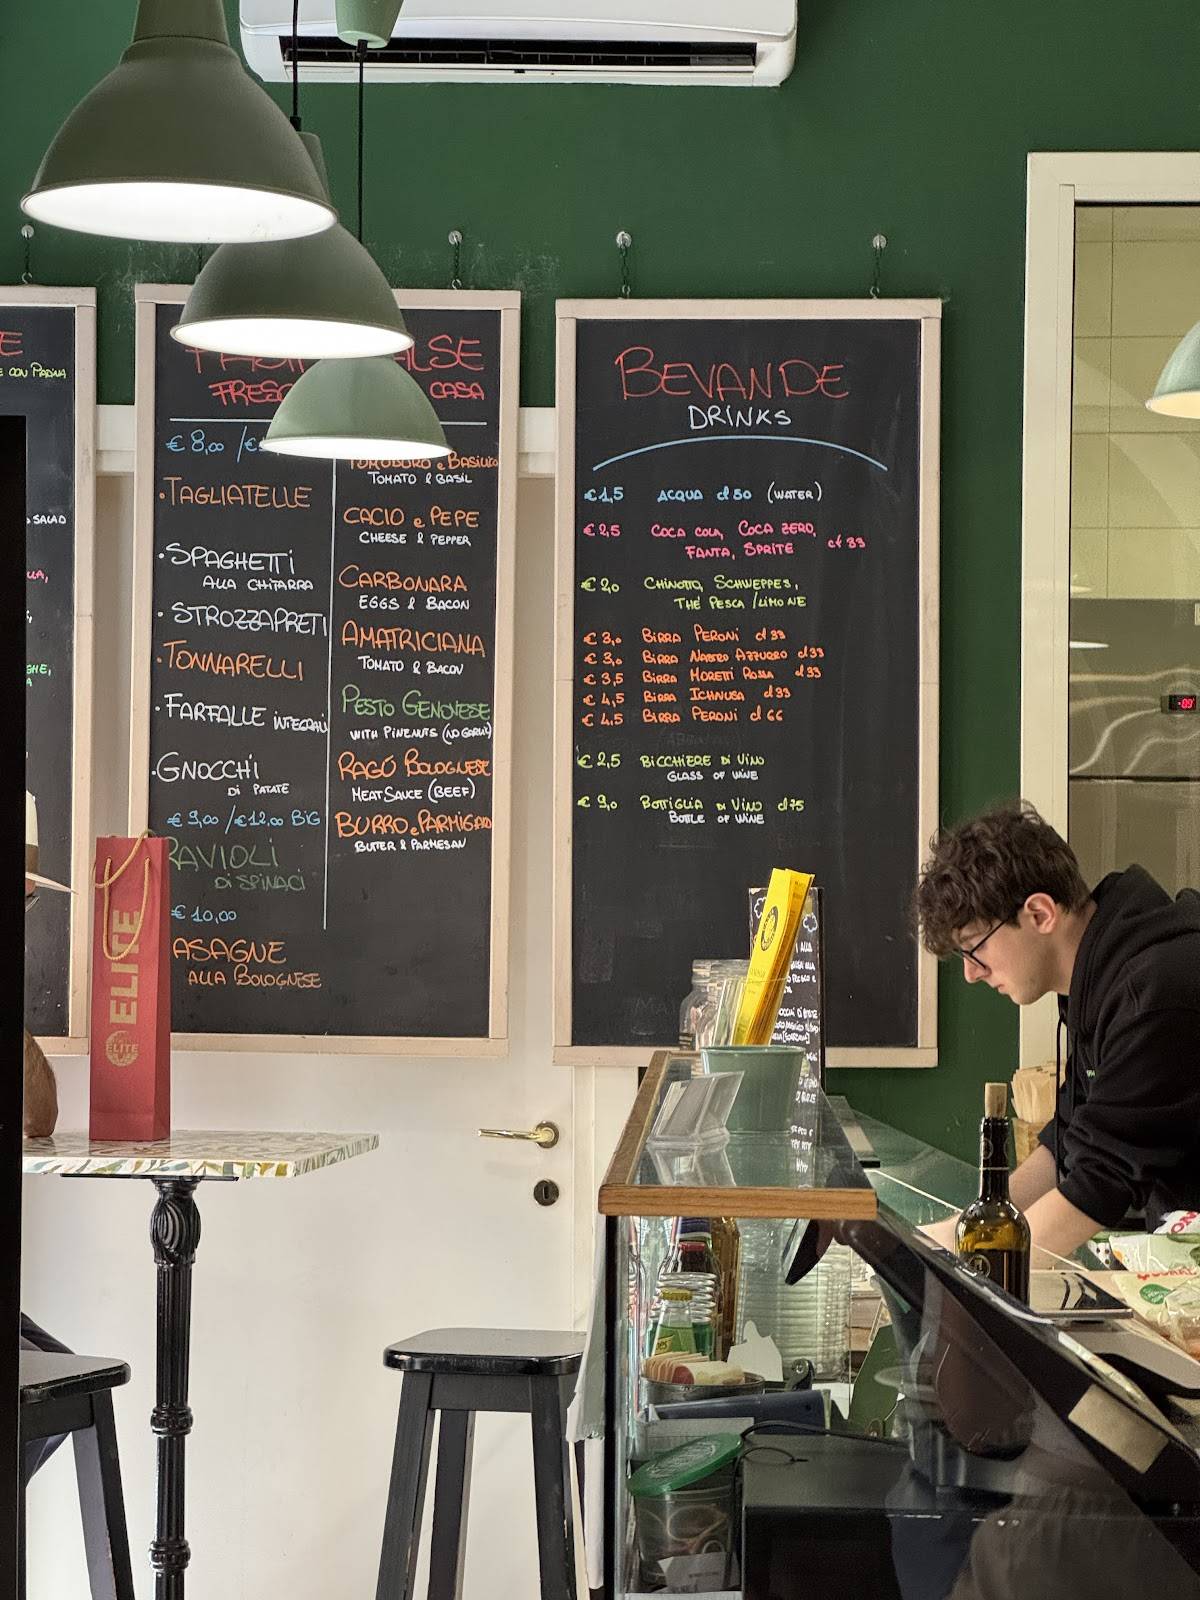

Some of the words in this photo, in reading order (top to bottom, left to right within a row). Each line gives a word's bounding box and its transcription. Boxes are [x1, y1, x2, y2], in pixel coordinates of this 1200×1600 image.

[615, 347, 848, 401] BEVANDE
[429, 381, 485, 401] CASA
[688, 405, 791, 429] DRINKS
[367, 471, 416, 484] TOMATO
[436, 473, 472, 484] BASIL
[164, 477, 312, 508] TAGLIATELLE
[657, 490, 703, 502] ACQUA
[768, 481, 821, 503] (WATER)
[33, 514, 66, 524] SALAD
[344, 507, 404, 525] CACIO
[430, 506, 479, 527] PEPE
[651, 524, 685, 537] COCA
[738, 520, 773, 536] COCA
[782, 523, 816, 537] ZERO,
[359, 532, 407, 544] CHEESE
[431, 534, 471, 546] PEPPER
[166, 543, 294, 574] SPAGHETTI
[685, 546, 735, 560] FANTA,
[744, 542, 793, 556] SPRITE
[203, 575, 236, 589] ALLA
[339, 565, 467, 592] CARBONARA
[359, 595, 399, 610] EGGS
[426, 596, 469, 610] BACON
[709, 596, 744, 609] PESCA
[172, 602, 327, 636] STROZZAPRETI
[342, 620, 485, 657] AMATRICIANA
[642, 628, 681, 643] BIRRA
[694, 624, 739, 641] PERONI
[163, 640, 302, 681] TONNARELLI
[358, 656, 404, 671] TOMATO
[426, 661, 463, 675] BACON
[643, 650, 678, 664] BIRRA
[643, 670, 677, 684] BIRRA
[690, 667, 734, 681] MORETTI
[342, 684, 394, 717] PESTO
[402, 690, 490, 720] GENOVESE
[644, 691, 676, 702] BIRRA
[690, 688, 744, 701] ICHNUSA
[164, 693, 266, 726] FARFALLE
[643, 709, 680, 723] BIRRA
[692, 706, 737, 721] PERONI
[350, 729, 378, 740] WITH
[157, 752, 259, 782] GNOCCHI
[404, 748, 491, 777] BOLOGNESE
[640, 755, 711, 768] BICCHIERE
[737, 753, 764, 765] VINO
[667, 771, 703, 782] GLASS
[732, 769, 758, 780] WINE
[253, 783, 289, 795] PATATE
[352, 787, 383, 801] MEAT
[384, 786, 423, 802] SAUCE
[428, 778, 475, 803] (BEEF)
[640, 795, 703, 810] BOTTIGLIA
[731, 798, 762, 812] VINO
[292, 810, 320, 826] BIG
[335, 812, 408, 837] BURRO
[669, 810, 705, 824] BOTTLE
[735, 813, 764, 824] WINE
[411, 838, 466, 850] PARMESAN
[169, 837, 279, 872] RAVIOLI
[173, 938, 286, 963] ASAGNE
[109, 909, 141, 1025] ELITE
[189, 971, 226, 985] ALLA
[234, 964, 321, 989] BOLOGNESE
